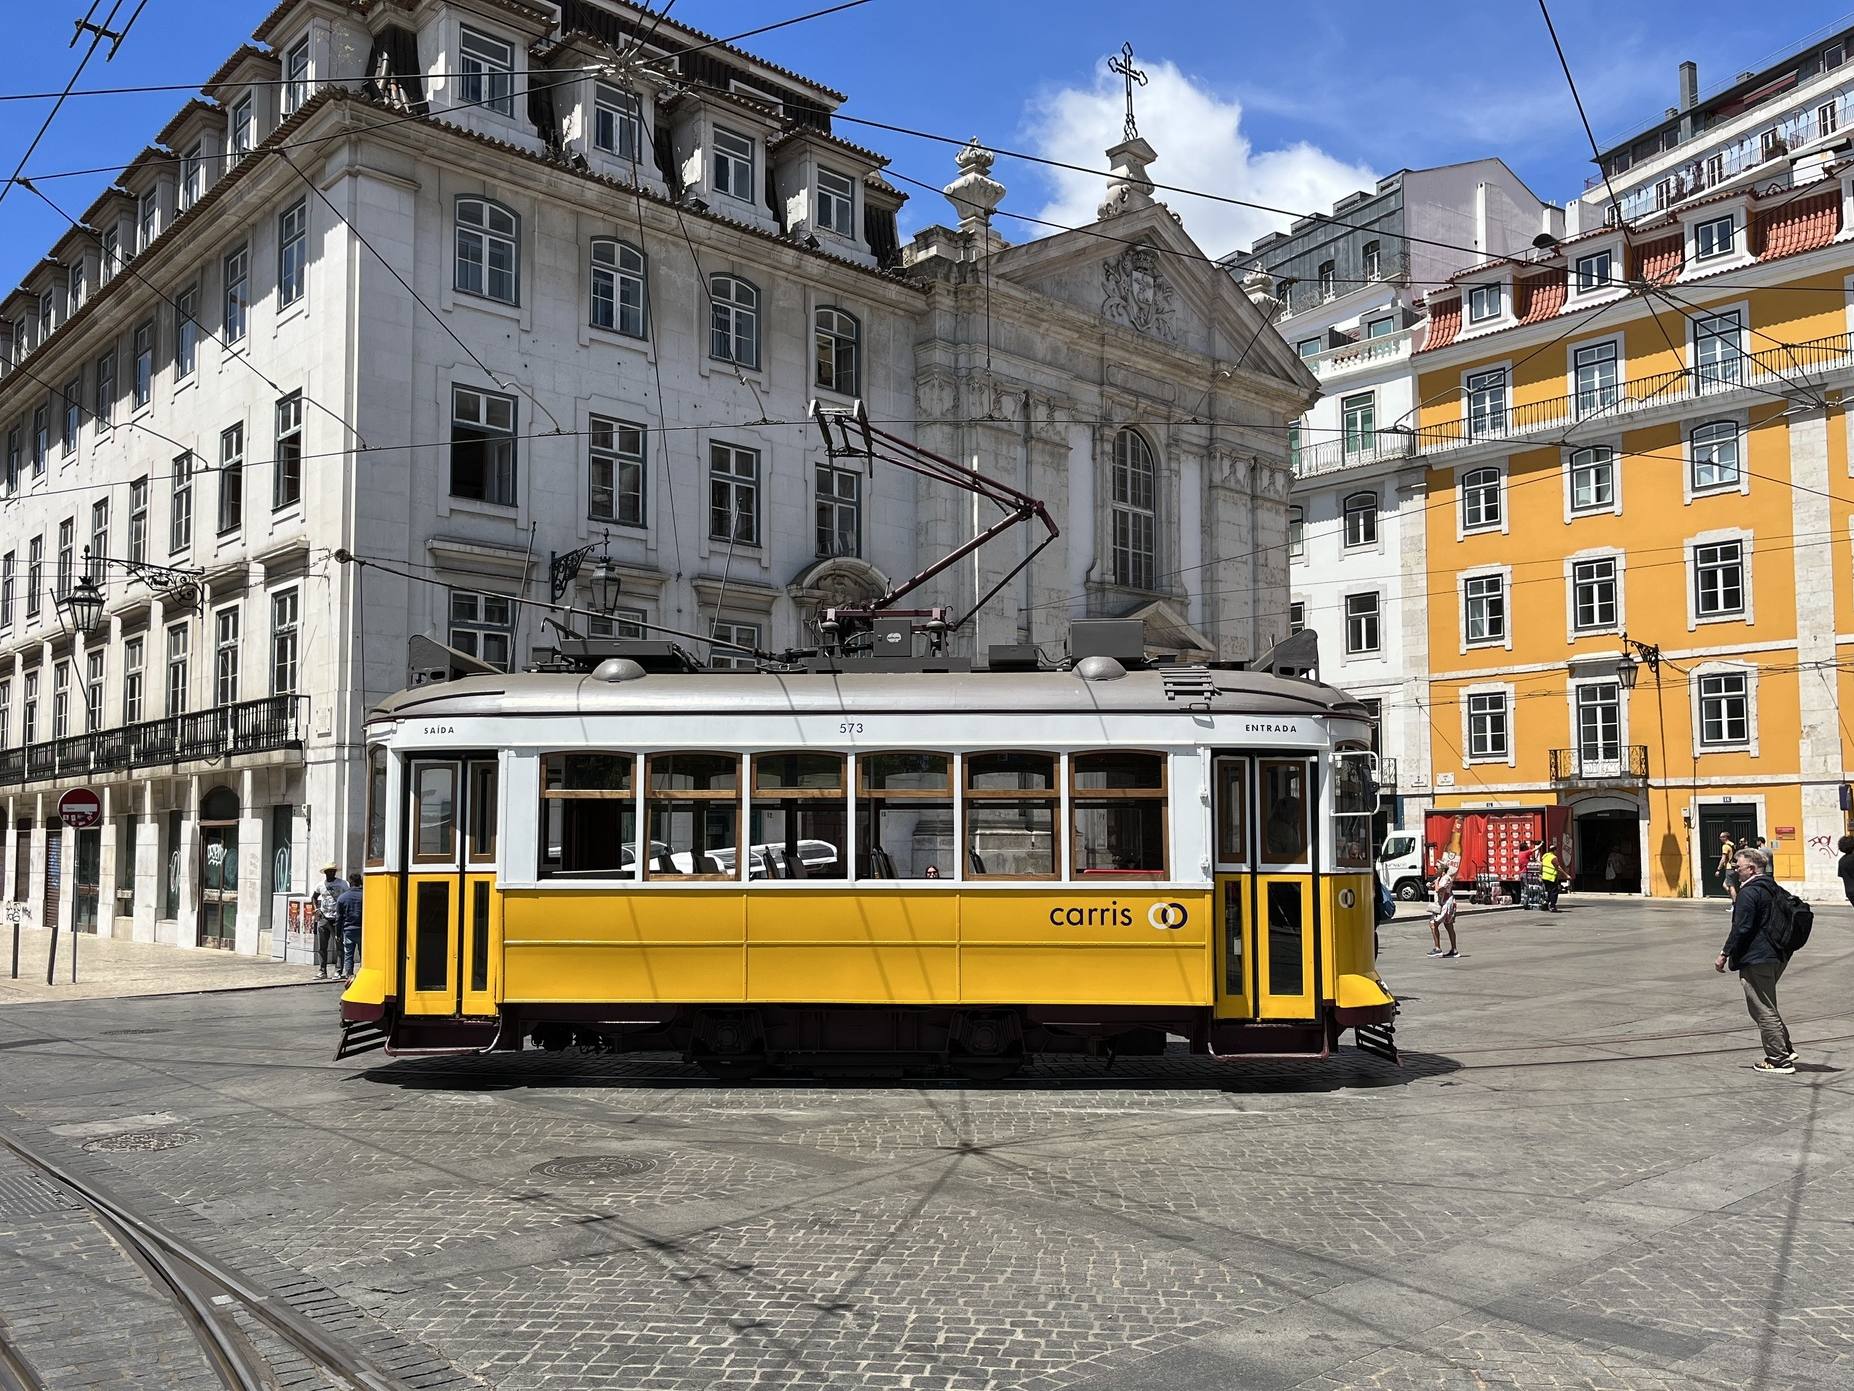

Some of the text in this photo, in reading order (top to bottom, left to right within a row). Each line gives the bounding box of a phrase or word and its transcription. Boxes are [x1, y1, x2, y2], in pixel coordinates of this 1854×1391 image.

[424, 724, 454, 734] SAÍDA
[840, 723, 863, 733] 573
[1245, 724, 1297, 732] ENTRADA
[1049, 900, 1133, 927] carris
